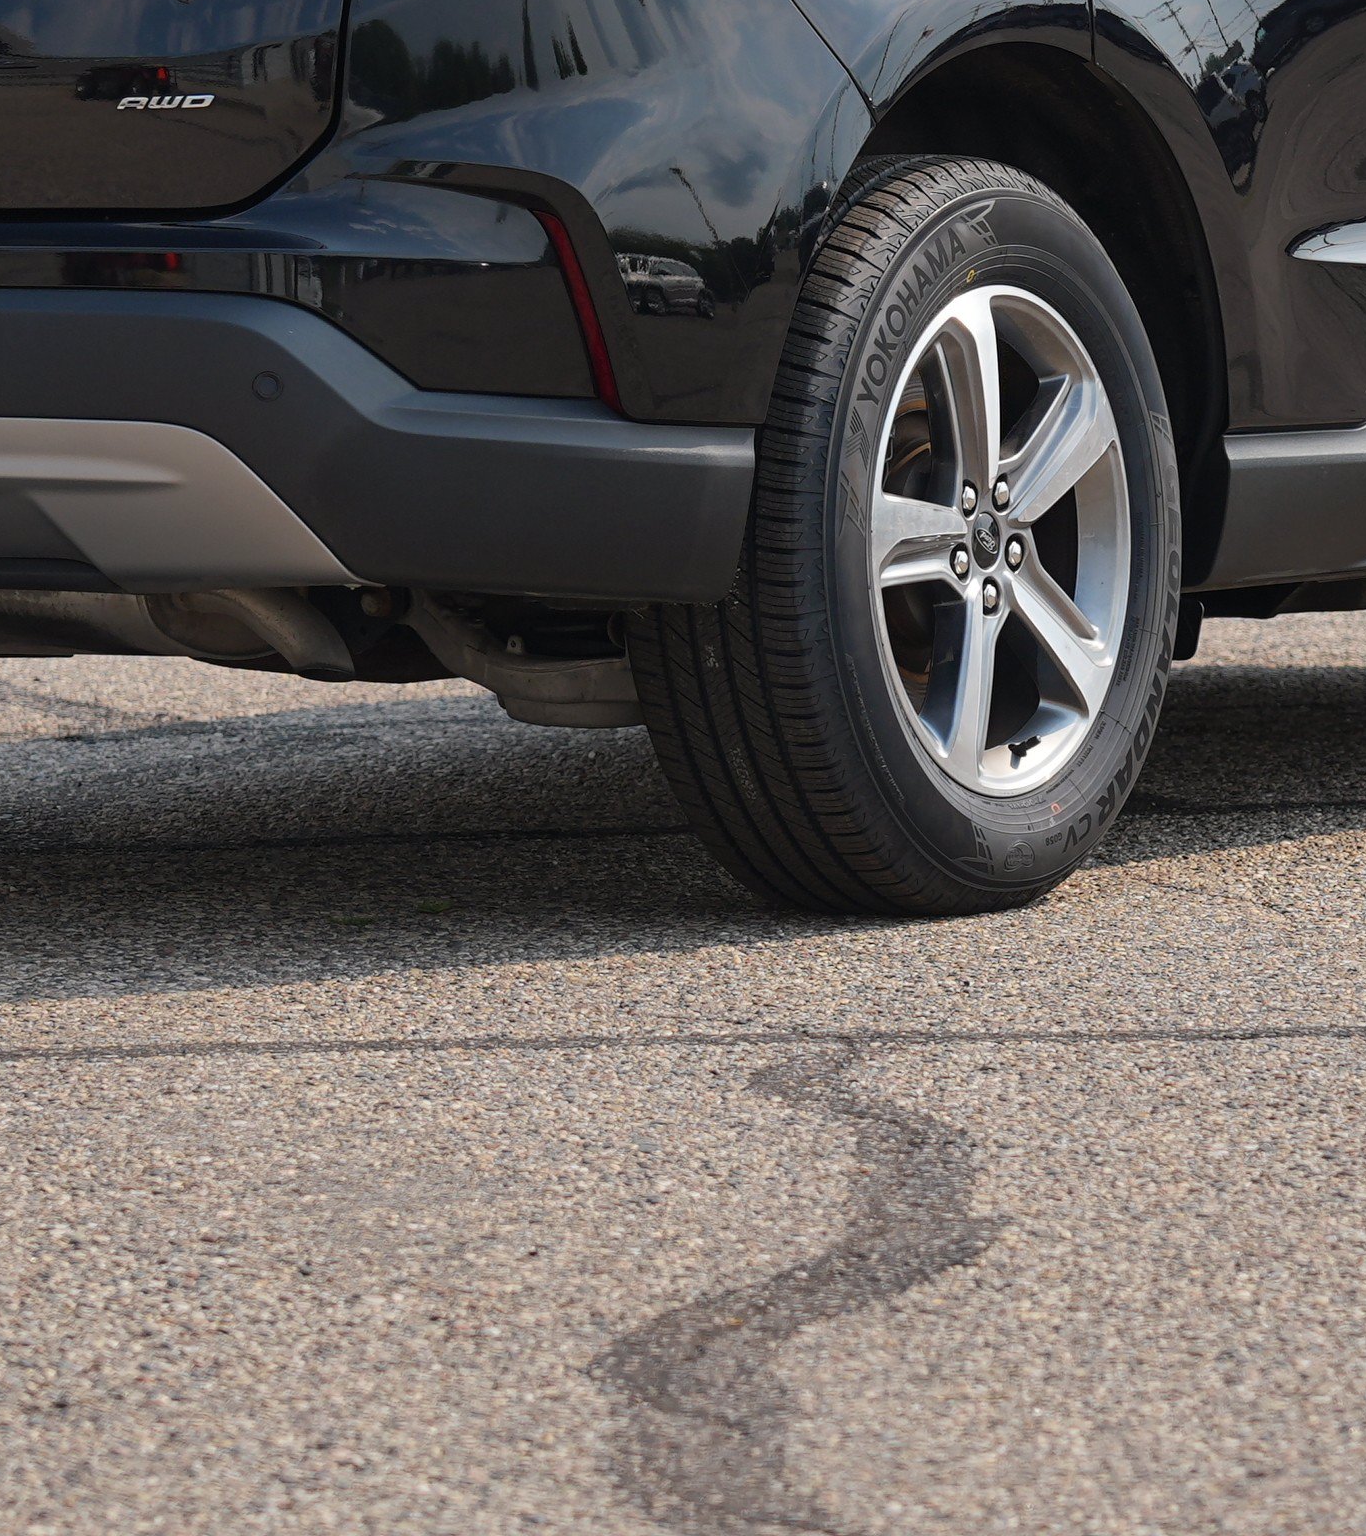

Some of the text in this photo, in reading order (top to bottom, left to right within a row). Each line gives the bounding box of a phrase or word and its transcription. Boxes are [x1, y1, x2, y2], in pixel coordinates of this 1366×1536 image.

[116, 94, 217, 110] AWD
[856, 226, 967, 407] YOKOHAMA
[1062, 812, 1092, 854] CV
